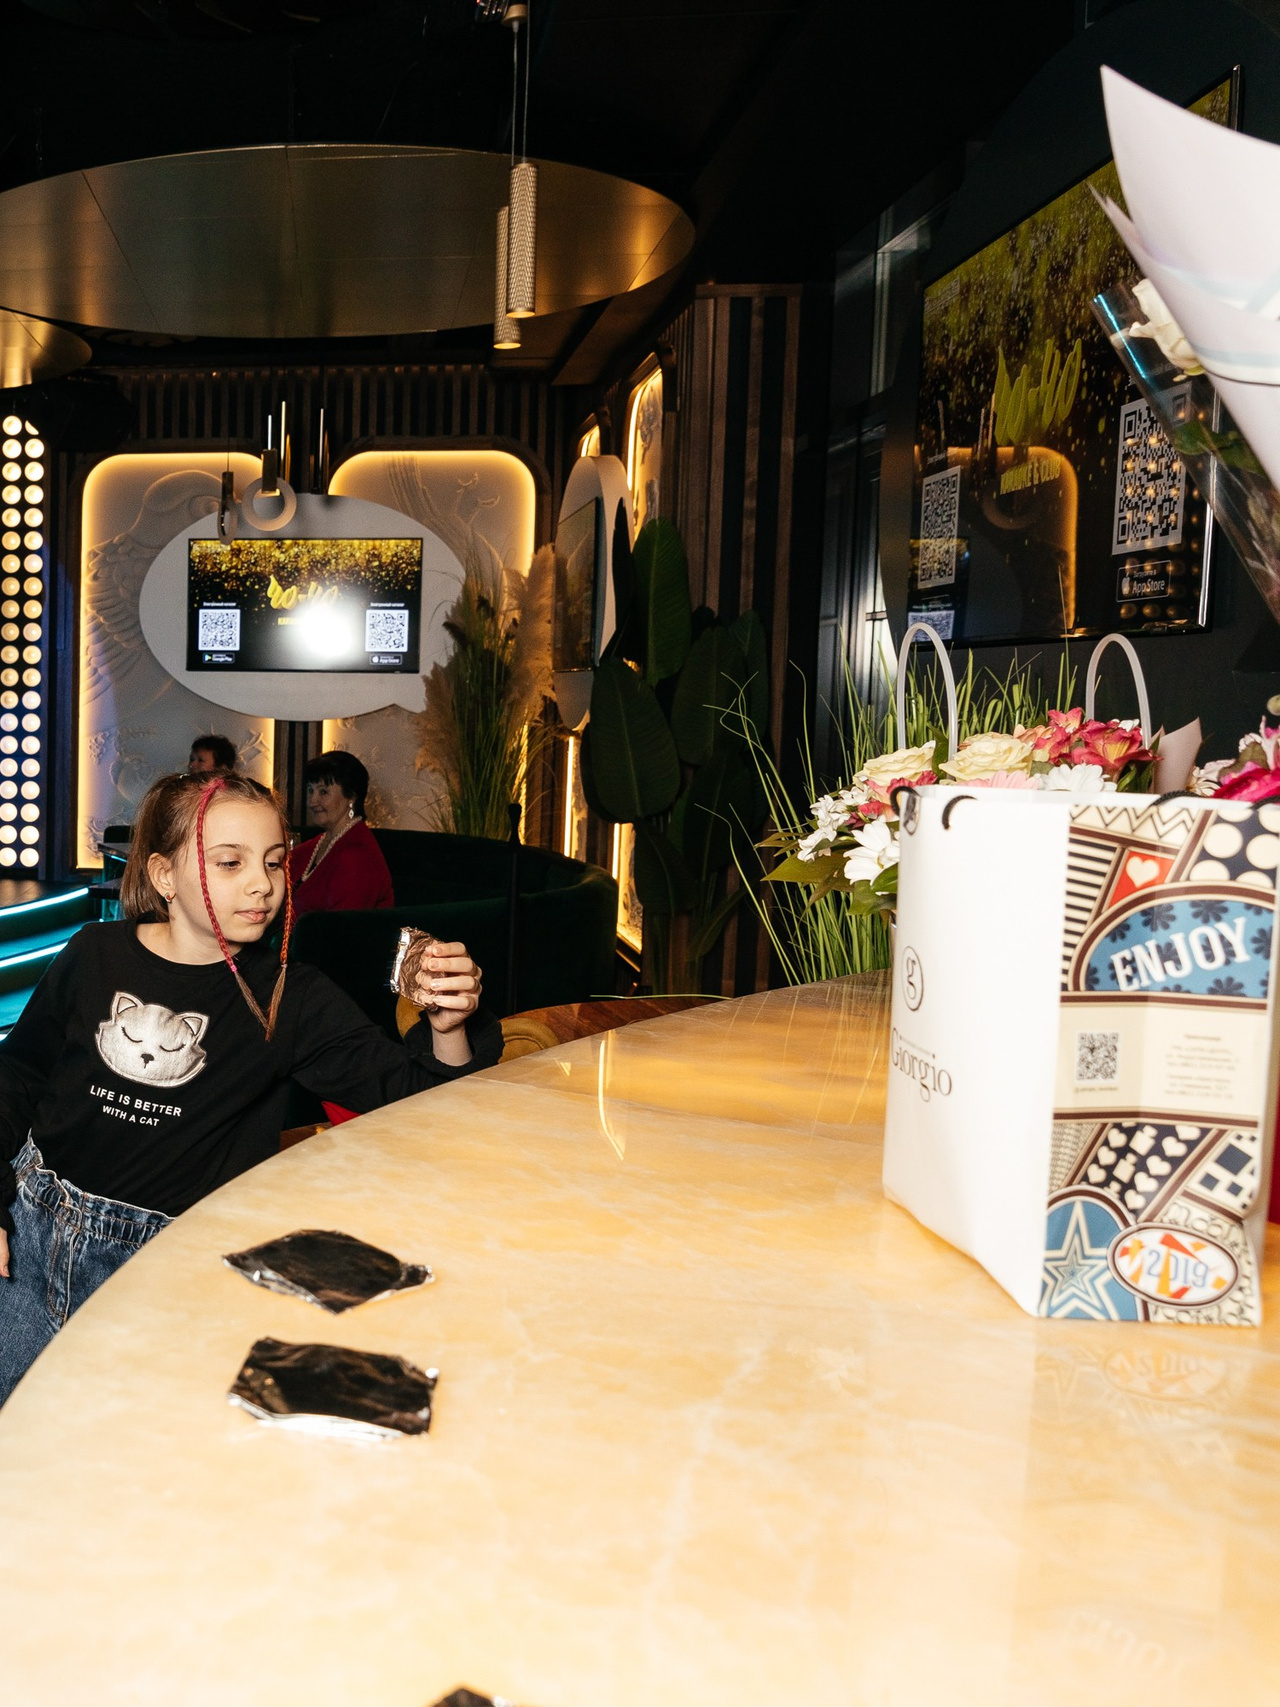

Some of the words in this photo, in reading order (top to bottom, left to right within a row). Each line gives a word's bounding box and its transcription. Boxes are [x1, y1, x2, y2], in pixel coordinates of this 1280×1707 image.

[1110, 917, 1251, 991] ENJOY
[891, 1027, 952, 1102] Giorgio
[90, 1085, 115, 1101] LIFE
[119, 1094, 131, 1105] IS
[134, 1099, 182, 1117] BETTER
[102, 1105, 127, 1119] WITH
[128, 1114, 136, 1123] A
[139, 1116, 160, 1126] CAT
